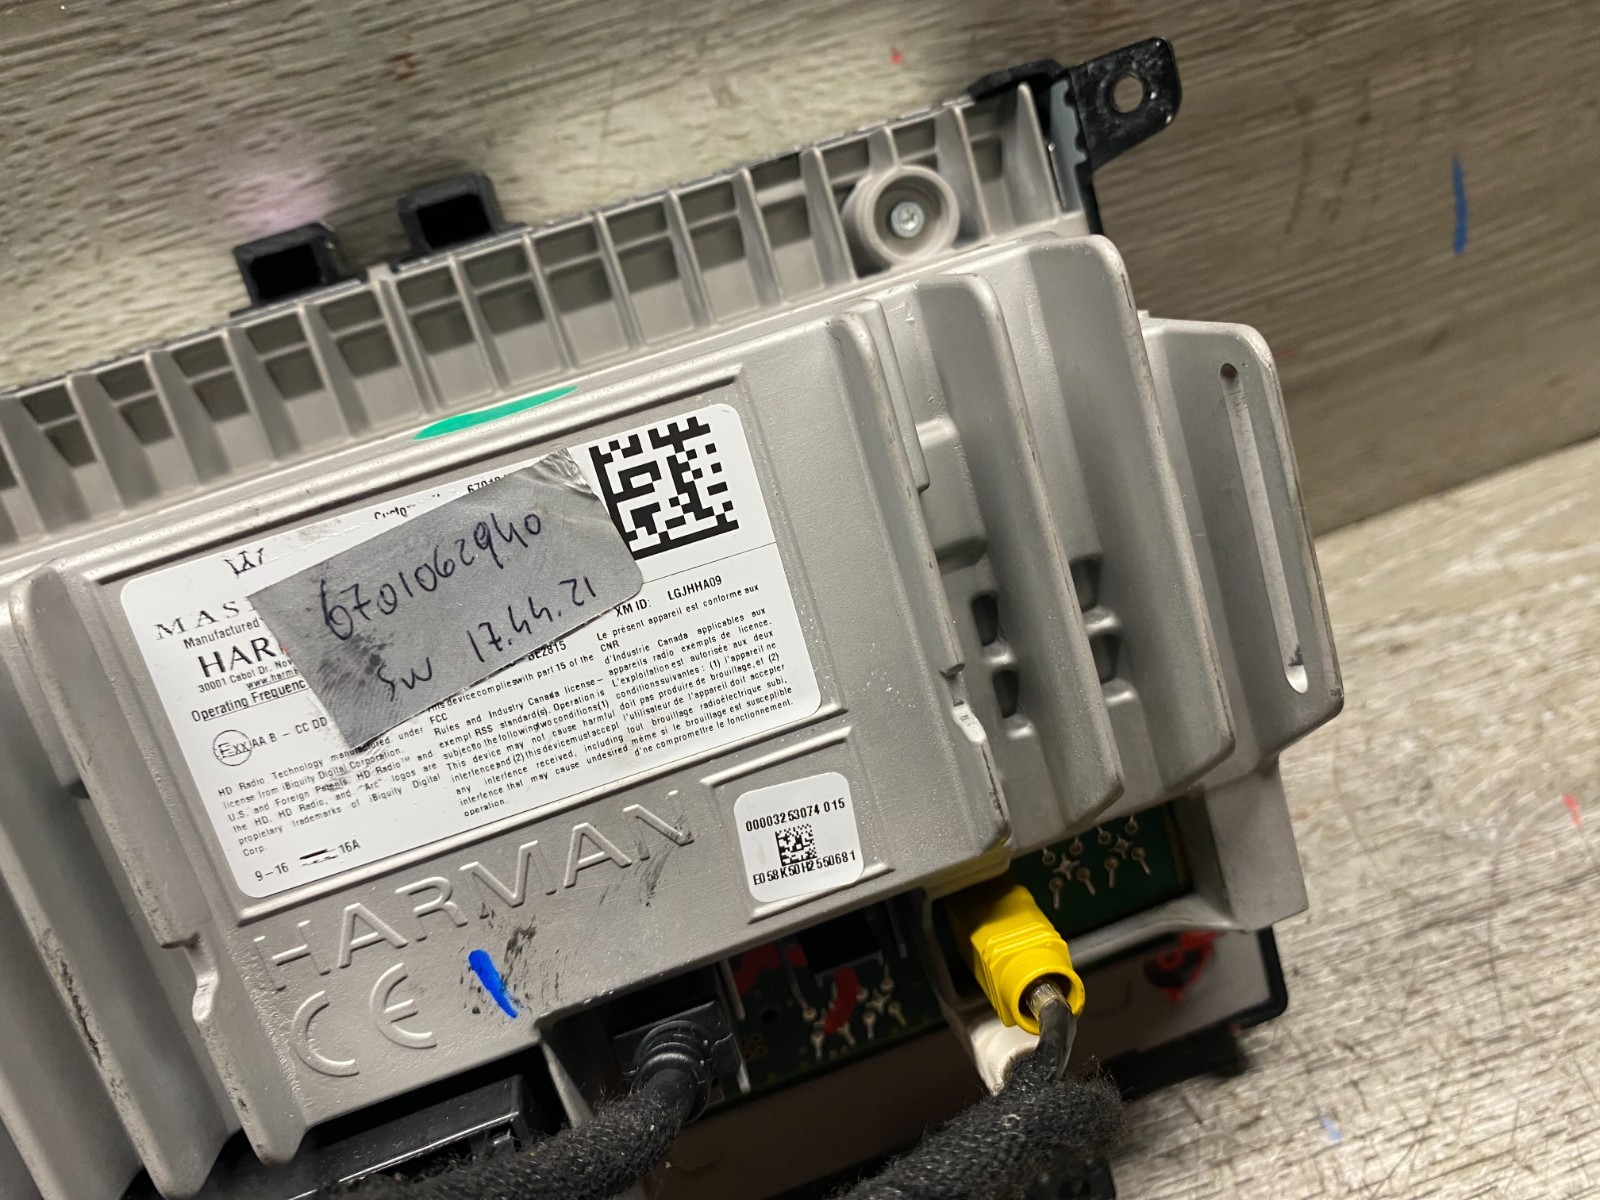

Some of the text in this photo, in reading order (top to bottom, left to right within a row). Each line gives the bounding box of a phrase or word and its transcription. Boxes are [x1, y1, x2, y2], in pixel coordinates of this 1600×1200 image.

[320, 512, 542, 641] 6701062940
[613, 575, 722, 617] XM ID: LGJHHA09
[155, 600, 254, 641] MAS
[182, 617, 259, 649] Manufactured
[596, 584, 759, 641] Le présent appareil est conforme aux
[600, 639, 619, 652] CNR
[604, 608, 765, 664] d'Industrie Canada applicables aux
[608, 658, 648, 676] appareils
[652, 649, 674, 661] radio
[720, 631, 730, 640] de
[737, 619, 771, 633] licence.
[689, 644, 728, 662] autorisée
[732, 638, 747, 648] aux
[753, 630, 773, 641] deux
[709, 659, 720, 670] (1)
[724, 644, 764, 664] l'appareil
[766, 642, 776, 650] ne
[197, 677, 227, 693] 30001
[257, 665, 272, 675] Dr.
[536, 666, 554, 679] part
[555, 661, 566, 671] 15
[569, 657, 577, 667] of
[579, 654, 594, 663] the
[619, 699, 636, 710] doit
[639, 694, 654, 706] pas
[658, 681, 693, 699] produire
[695, 677, 705, 685] de
[768, 652, 779, 664] (2)
[673, 697, 684, 705] de
[687, 681, 727, 700] l'appareil
[729, 675, 746, 687] doit
[749, 664, 784, 680] accepter
[191, 697, 250, 722] Operating
[294, 722, 309, 734] CC
[311, 716, 327, 729] DD
[429, 712, 448, 724] FCC
[433, 723, 460, 736] Rules
[465, 714, 482, 726] and
[488, 702, 523, 719] Industry
[527, 690, 560, 706] Canada
[439, 689, 605, 748] exempt RSS standard(s). Operation is
[626, 675, 787, 734] tout brouillage radioélectrique subi,
[655, 725, 713, 749] compromettre
[716, 721, 724, 729] le
[726, 698, 793, 725] fonctionnement.
[660, 726, 668, 735] si
[672, 723, 681, 731] le
[685, 708, 726, 727] brouillage
[729, 702, 742, 712] est
[746, 686, 792, 707] susceptible
[217, 727, 423, 796] HD Radio Technology under
[445, 709, 615, 771] This device may not cause harmful
[483, 737, 498, 746] the
[512, 752, 524, 764] (2)
[455, 785, 471, 795] any
[536, 749, 577, 768] received,
[583, 734, 624, 752] including
[506, 779, 523, 790] that
[530, 772, 548, 782] may
[555, 761, 579, 774] cause
[586, 743, 628, 764] undesired
[223, 794, 255, 809] license
[257, 787, 279, 798] from
[281, 775, 315, 790] iBiquity
[227, 810, 249, 821] U.S.
[253, 802, 269, 814] and
[274, 791, 310, 806] Foreign
[356, 770, 371, 780] HD
[232, 823, 248, 833] the
[277, 808, 292, 818] HD
[298, 798, 328, 812] Radio,
[391, 769, 416, 782] logos
[422, 762, 437, 772] are
[291, 806, 342, 827] trademarks
[350, 798, 360, 808] of
[368, 787, 402, 802] iBiquity
[412, 772, 440, 788] Digital
[464, 799, 508, 817] operation.
[242, 845, 267, 857] Corp.
[253, 789, 695, 991] HARMAN
